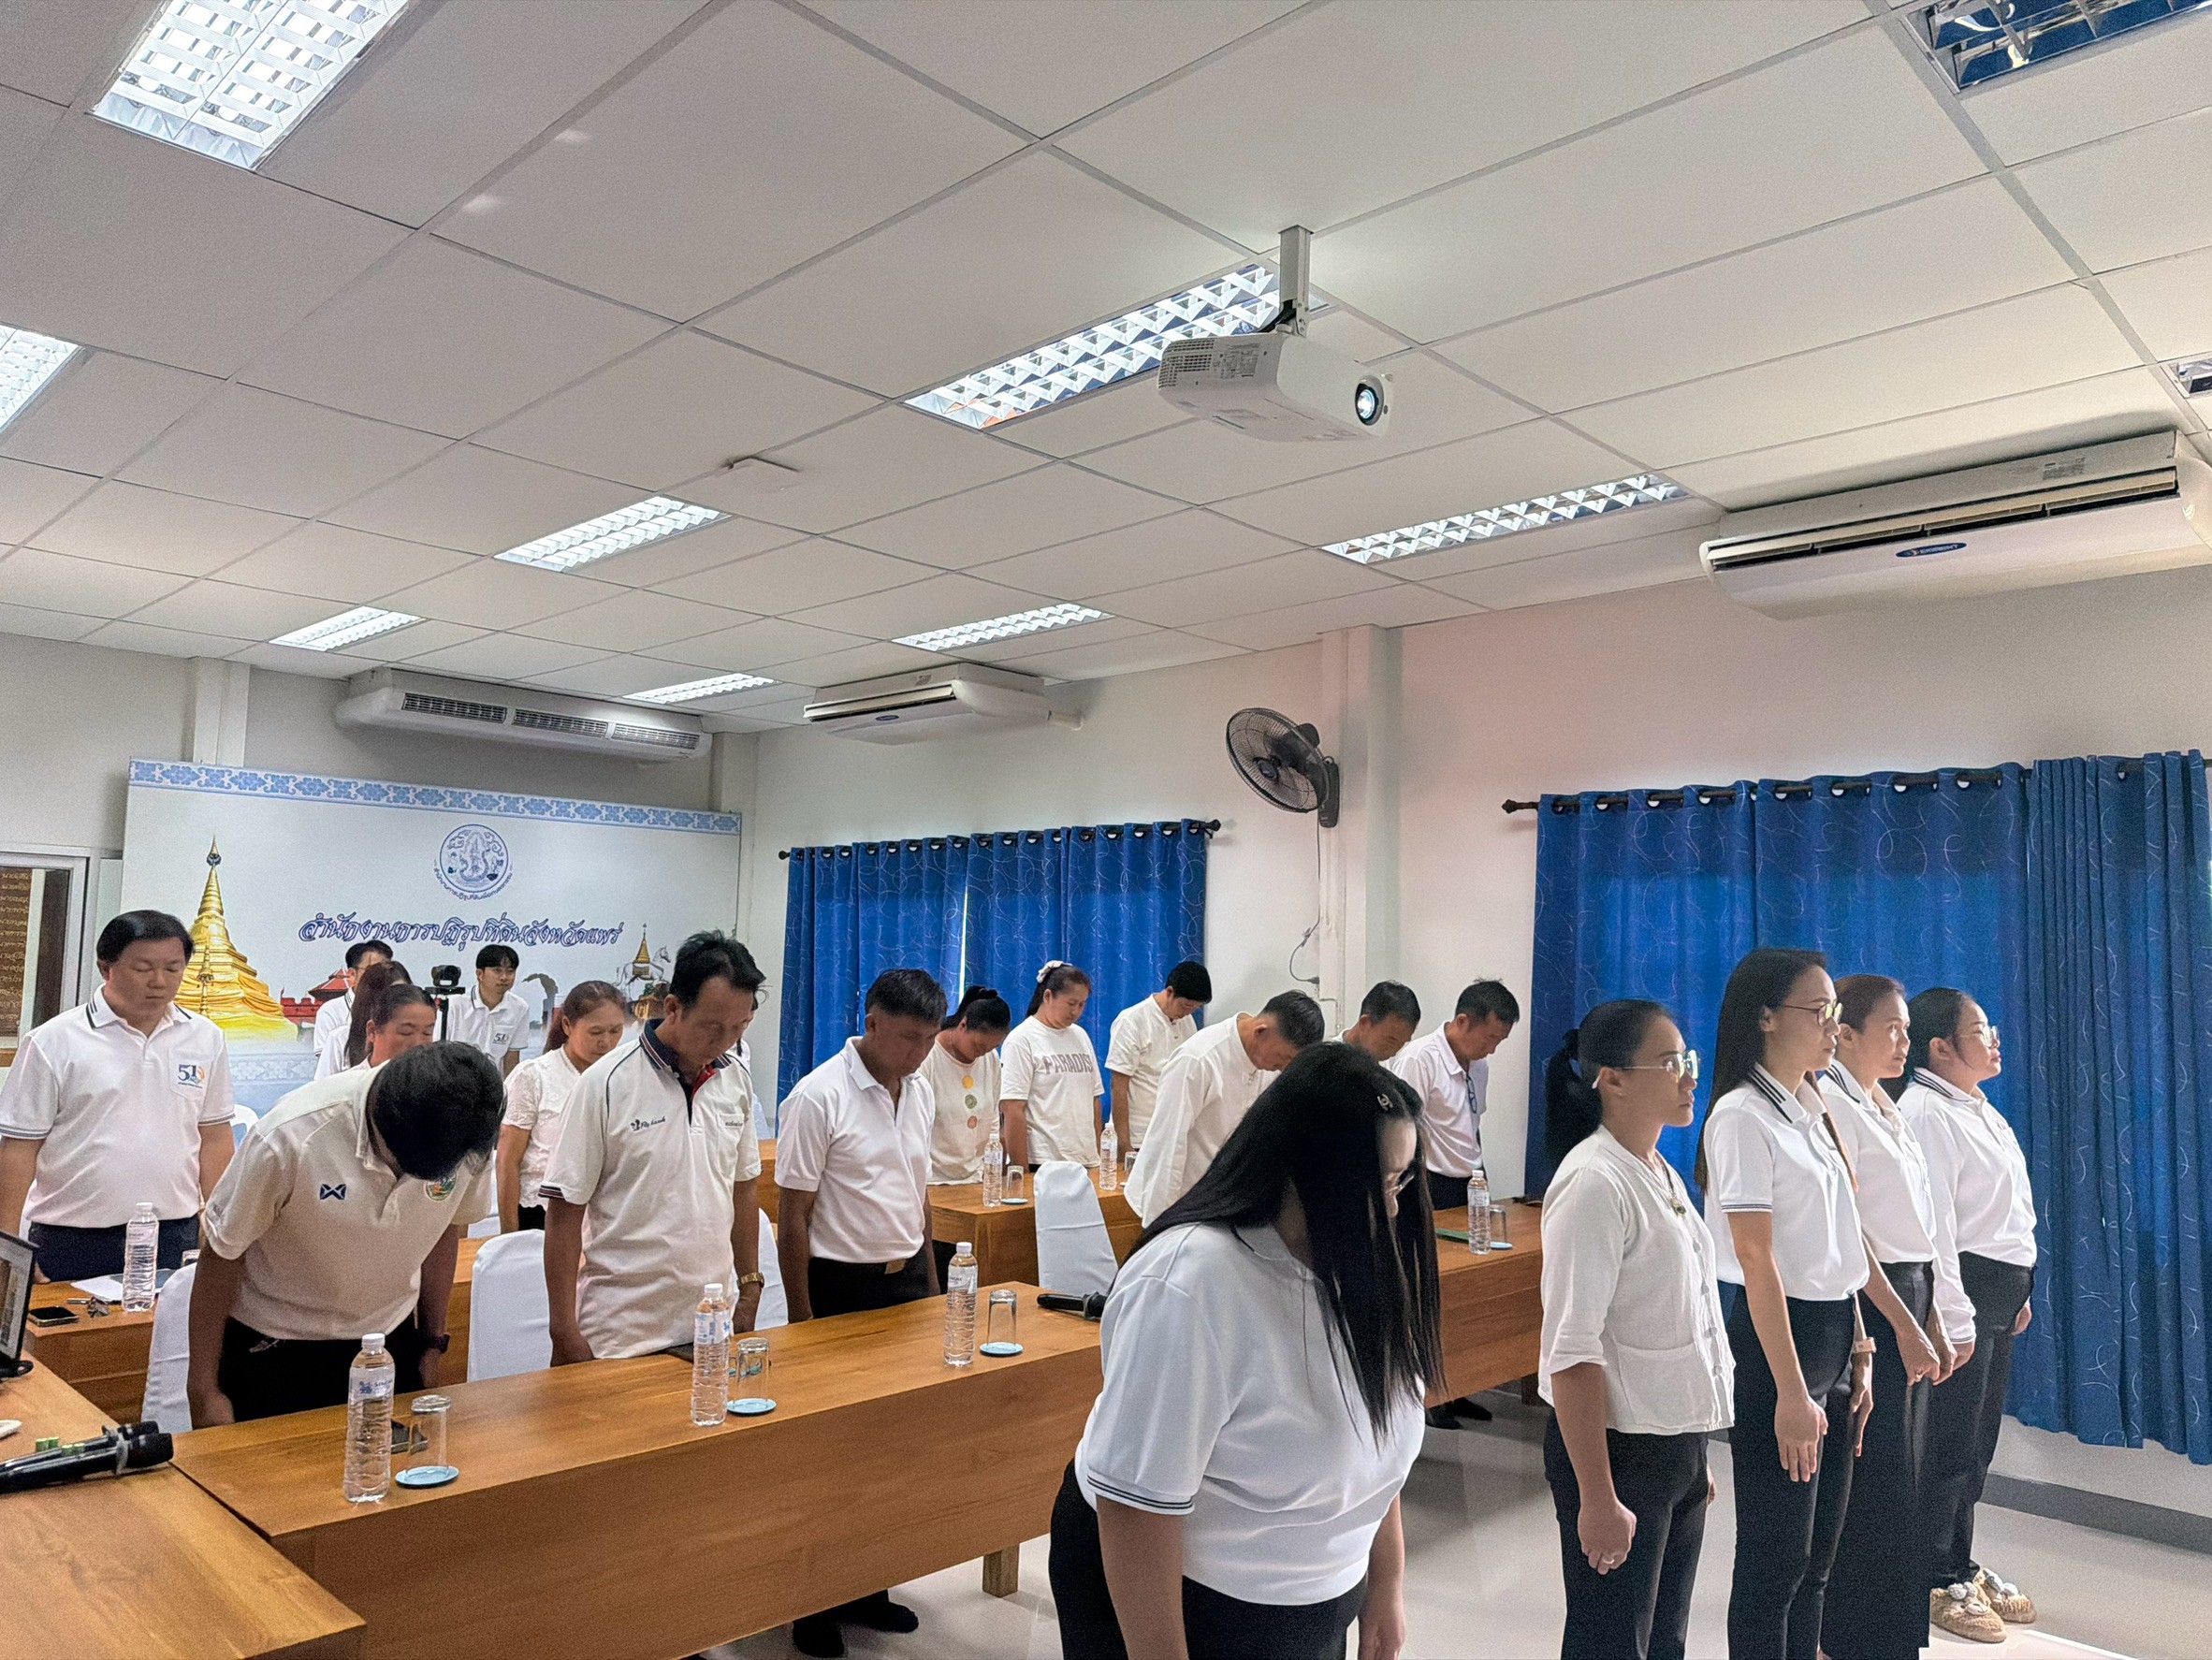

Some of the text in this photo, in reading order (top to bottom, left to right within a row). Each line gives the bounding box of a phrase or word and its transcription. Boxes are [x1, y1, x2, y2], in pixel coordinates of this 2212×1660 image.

[298, 911, 625, 952] สำนักงานการปฏิรูปที่ดินจังหวัดแพร่
[178, 1064, 196, 1082] 51
